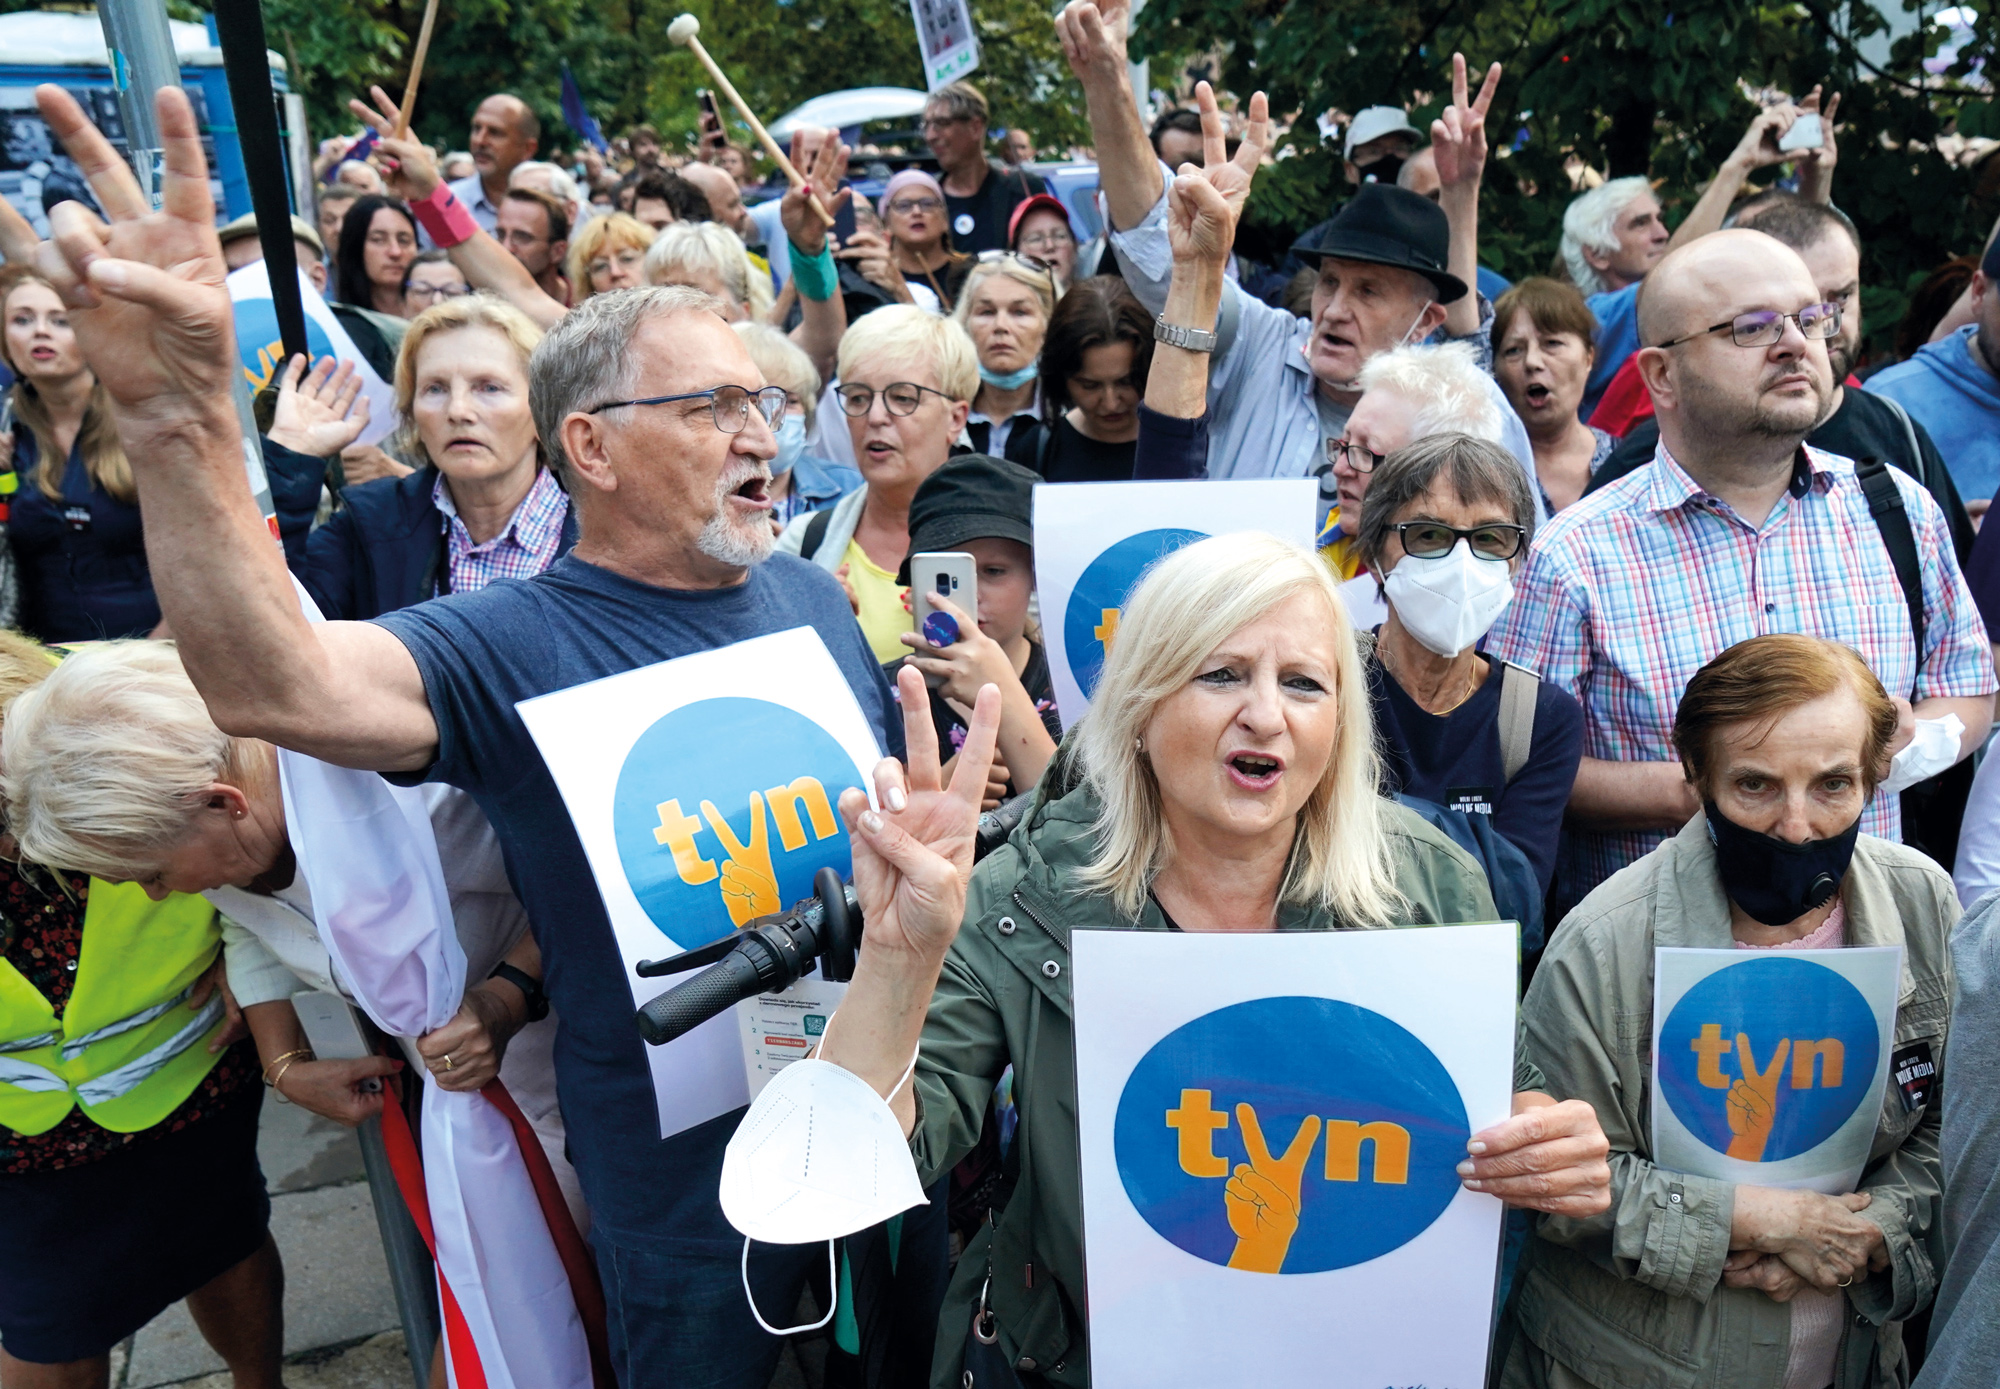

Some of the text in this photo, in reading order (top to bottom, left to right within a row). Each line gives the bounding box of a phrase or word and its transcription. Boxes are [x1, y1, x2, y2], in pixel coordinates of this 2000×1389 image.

[653, 776, 839, 908] tvn
[1690, 1024, 1845, 1128] tvn
[1912, 1061, 1935, 1078] MEDIA
[1166, 1088, 1411, 1228] tvn
